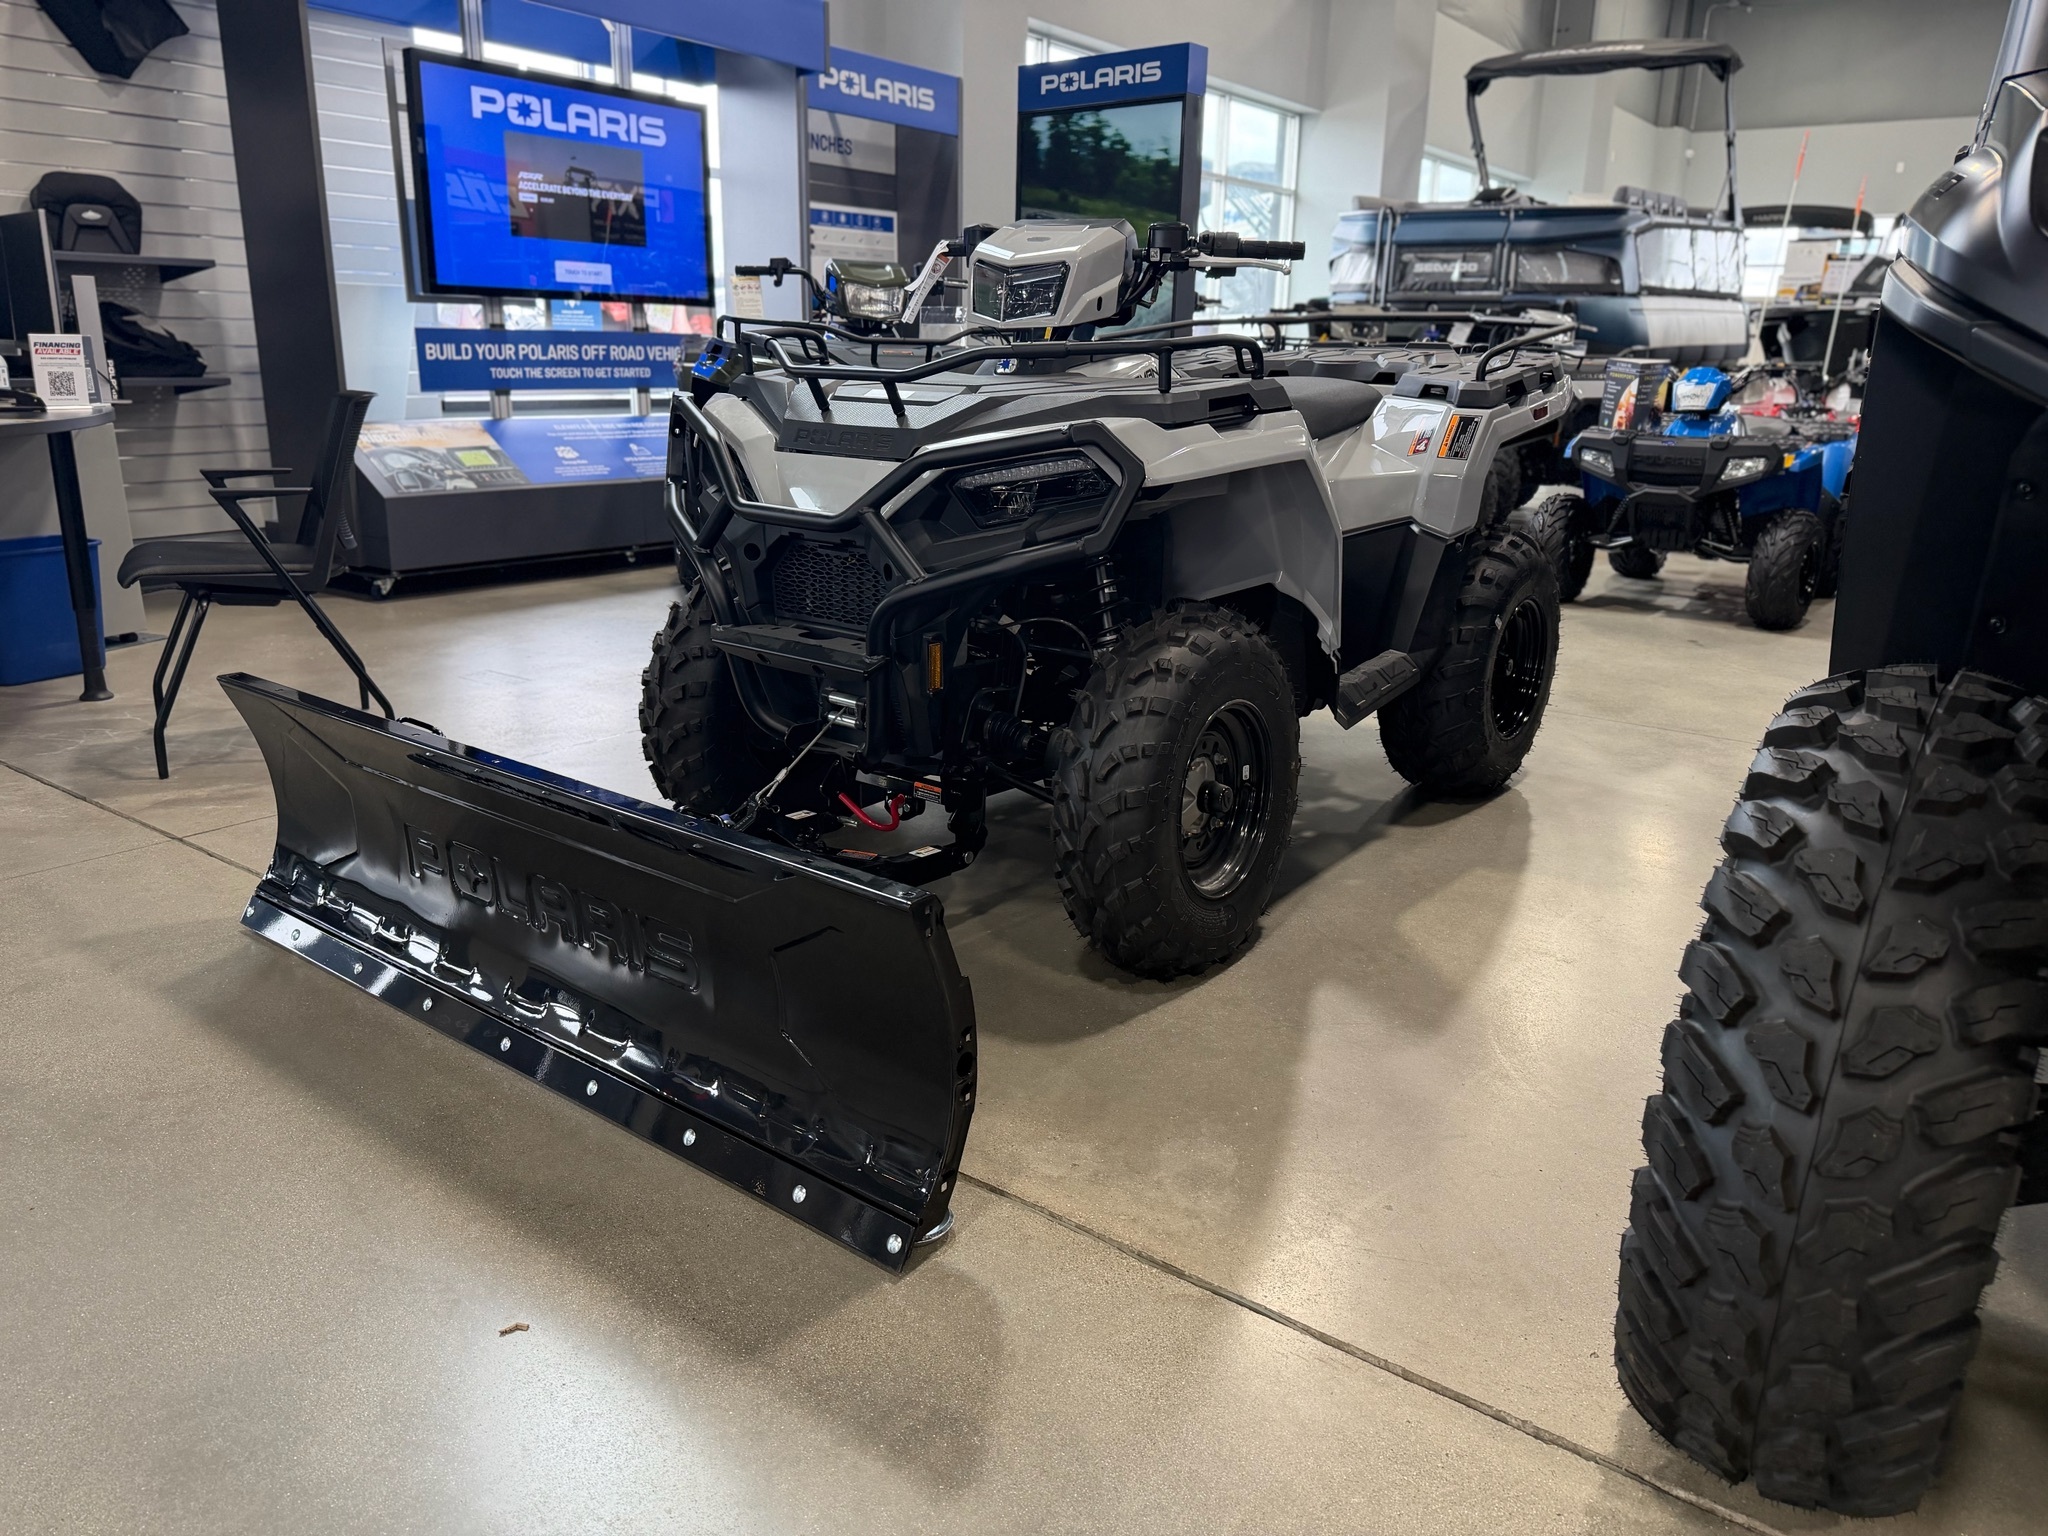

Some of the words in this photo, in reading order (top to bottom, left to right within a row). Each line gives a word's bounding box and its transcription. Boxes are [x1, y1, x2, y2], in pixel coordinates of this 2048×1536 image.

[818, 66, 936, 112] POLARIS
[1040, 61, 1162, 95] POLARIS
[470, 85, 667, 148] POLARIS
[808, 132, 853, 156] NCHES
[518, 180, 561, 194] ACCELERATE
[562, 186, 588, 197] BEYOND
[424, 343, 473, 361] BUILD
[474, 343, 517, 361] YOUR
[518, 344, 579, 361] POLARIS
[581, 345, 606, 361] OFF
[609, 345, 645, 361] ROAD
[646, 346, 684, 361] VEHIC
[490, 367, 523, 379] TOUCH
[524, 367, 543, 379] THE
[544, 367, 581, 379] SCREEN
[582, 367, 595, 378] TO
[595, 367, 612, 378] GET
[613, 367, 651, 378] STARTED
[794, 428, 895, 451] POLARIS
[402, 822, 701, 995] POLARIS
